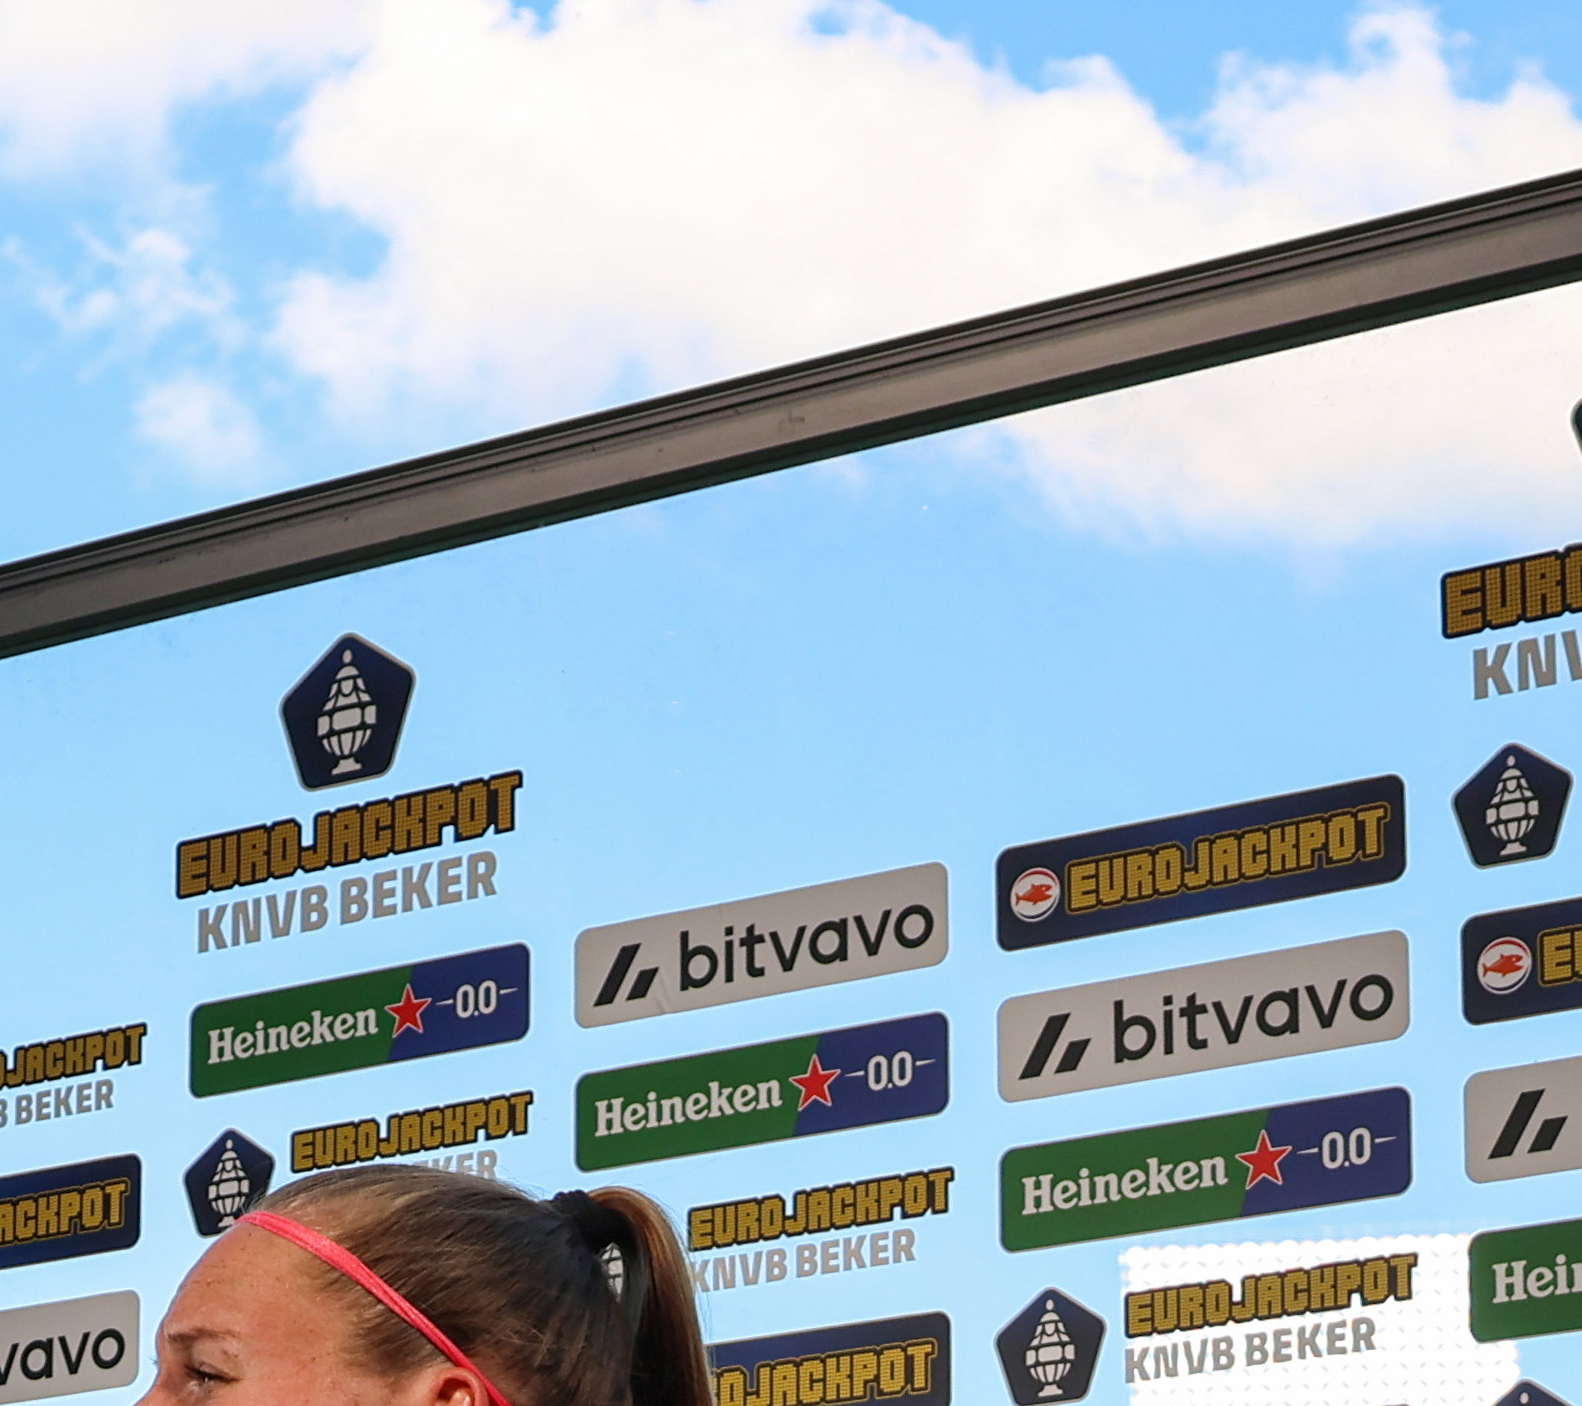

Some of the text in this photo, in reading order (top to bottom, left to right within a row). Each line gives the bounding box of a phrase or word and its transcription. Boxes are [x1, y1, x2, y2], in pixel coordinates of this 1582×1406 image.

[177, 773, 523, 898] EUROJACKPOT
[1067, 804, 1389, 913] EUROJACKPOT
[196, 852, 498, 954] KNVB BEKER
[680, 904, 935, 991] bitvavo
[207, 980, 497, 1065] Heineken 0.0
[1113, 973, 1394, 1064] bitvavo
[15, 1079, 115, 1126] BEKER
[291, 1090, 533, 1172] EUROJACKPOT
[594, 1050, 914, 1137] Heineken 0.0
[688, 1167, 954, 1251] EUROJACKPOT
[1021, 1126, 1372, 1215] Heineken 0.0
[691, 1228, 916, 1293] KNVB BEKER
[1125, 1252, 1418, 1339] EUROJACKPOT
[1124, 1316, 1376, 1384] KNVB BEKER
